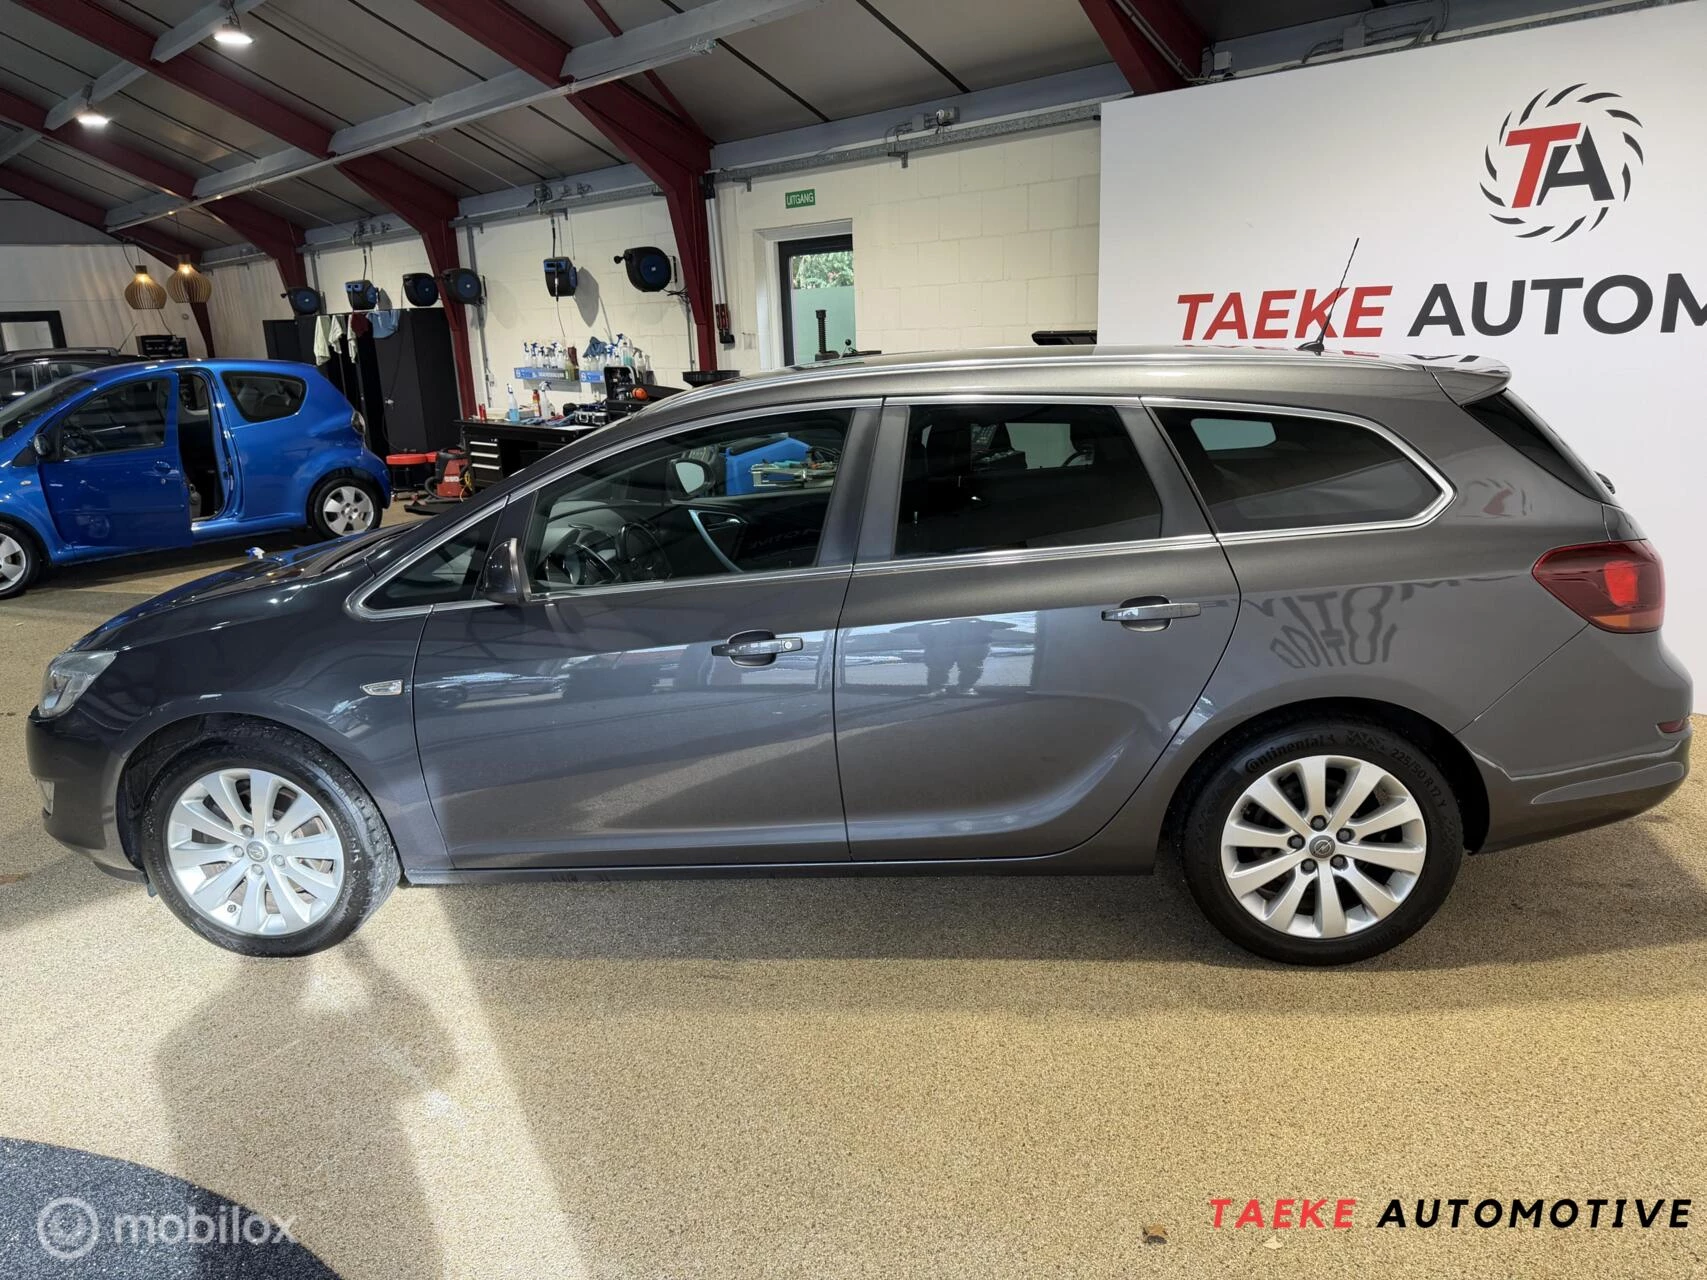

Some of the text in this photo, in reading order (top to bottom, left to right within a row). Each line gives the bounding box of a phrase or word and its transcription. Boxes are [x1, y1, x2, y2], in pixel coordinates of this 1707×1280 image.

[1505, 122, 1615, 209] TA
[786, 192, 814, 206] UITGANG
[1178, 286, 1393, 341] TAEKE
